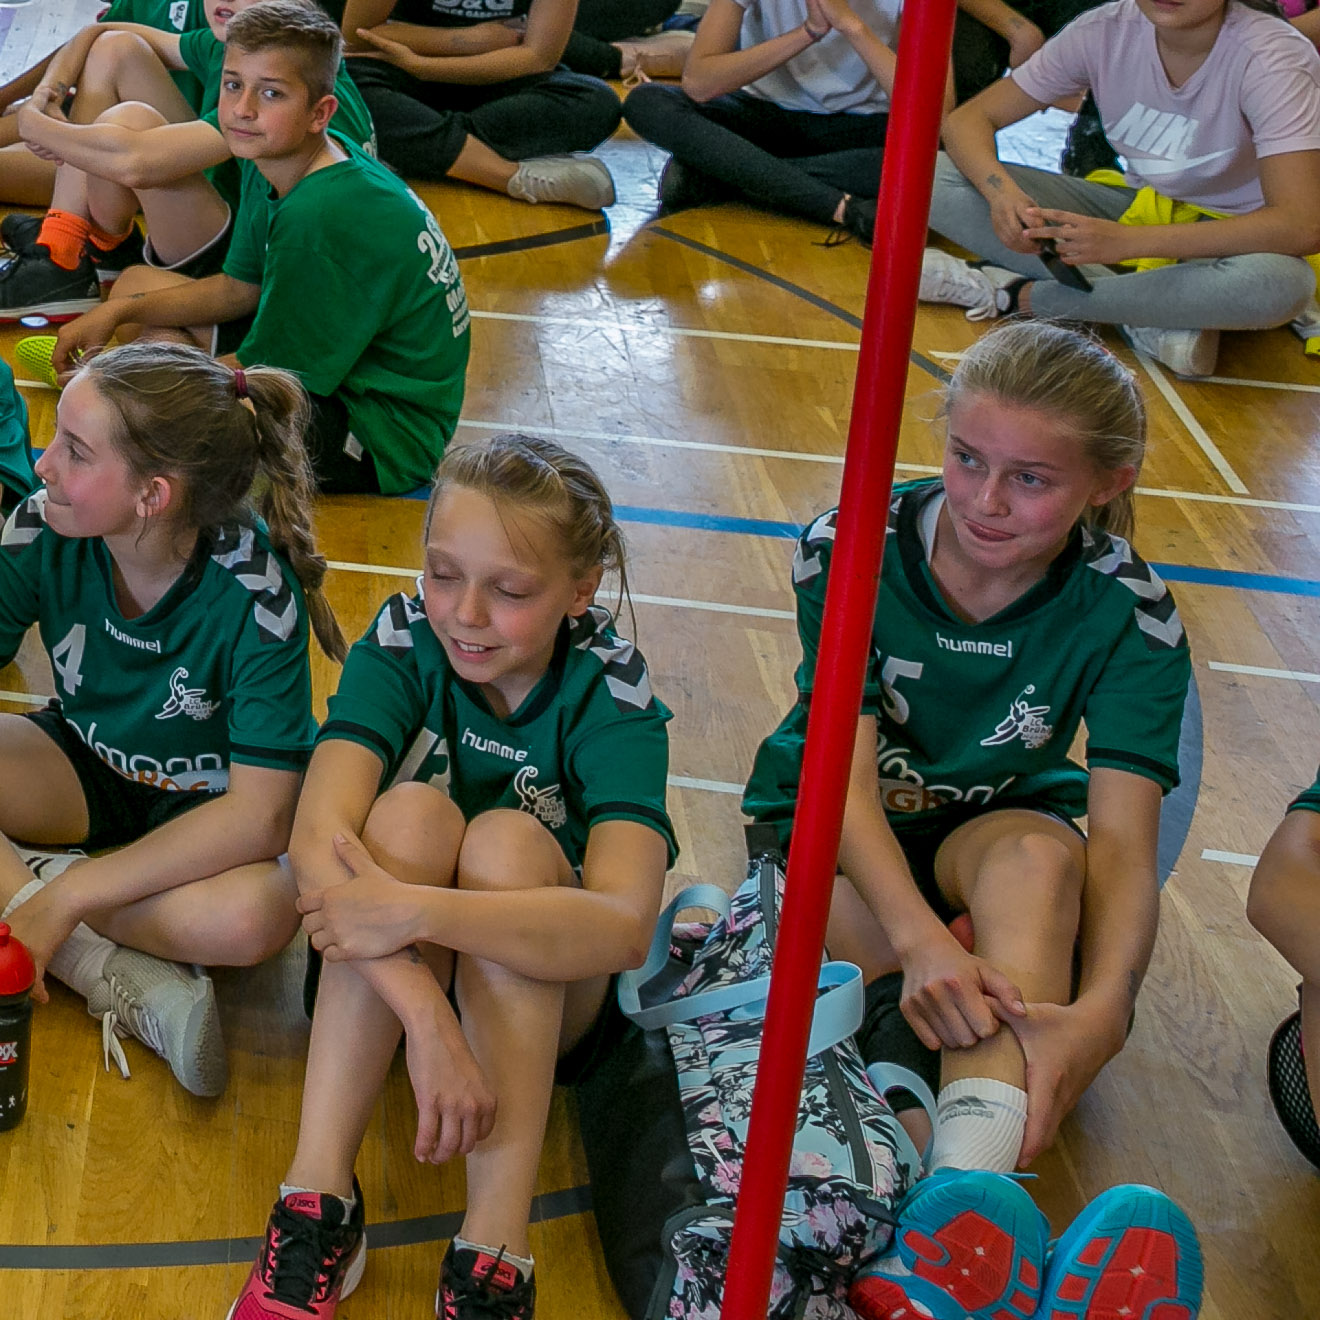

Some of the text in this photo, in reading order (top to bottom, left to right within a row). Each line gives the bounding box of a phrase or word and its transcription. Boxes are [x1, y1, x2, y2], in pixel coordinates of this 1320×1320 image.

[105, 617, 162, 654] hummel
[935, 631, 1013, 659] hummel
[52, 623, 87, 696] 4
[461, 727, 529, 762] humme
